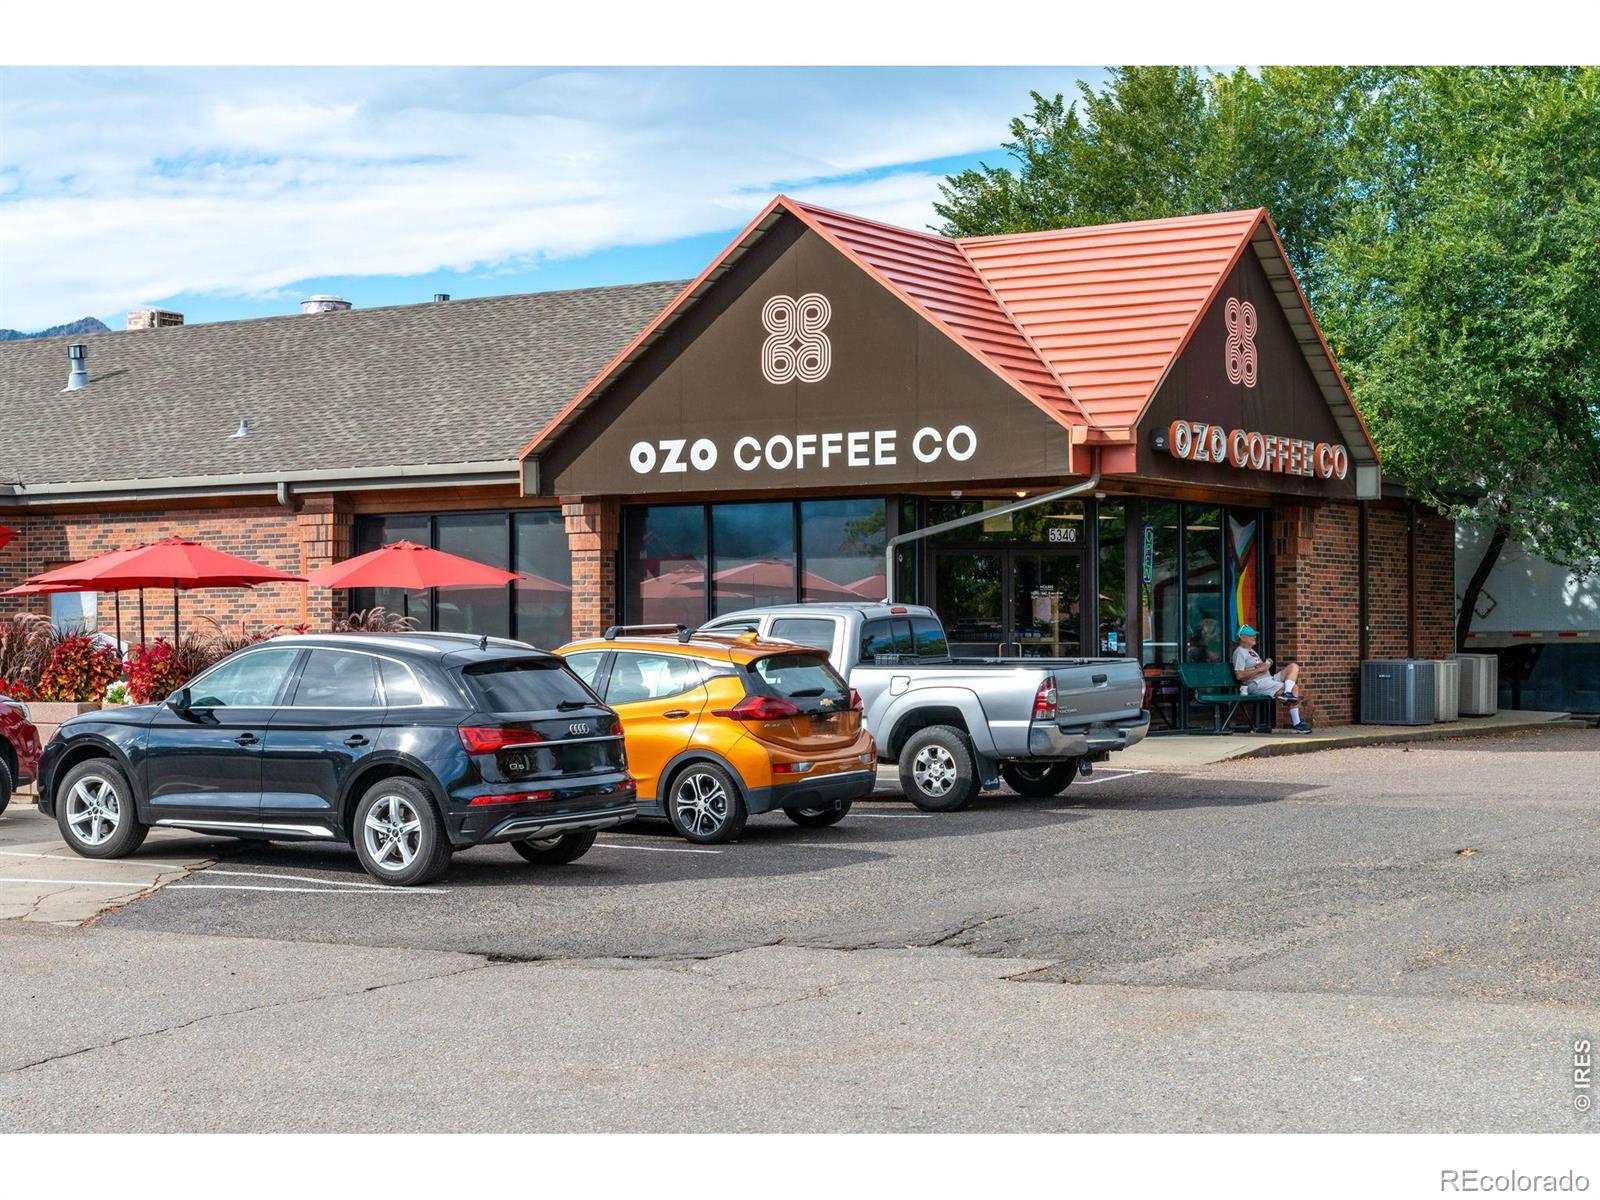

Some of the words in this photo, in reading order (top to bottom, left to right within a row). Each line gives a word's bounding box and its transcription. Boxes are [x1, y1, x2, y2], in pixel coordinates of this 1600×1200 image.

[630, 438, 717, 474] OZO
[733, 430, 897, 471] COFFEE
[912, 425, 977, 463] CO
[1169, 419, 1227, 463] OZO
[1228, 428, 1314, 477] COFFEE
[1314, 442, 1348, 480] CO
[1049, 528, 1076, 542] 5340
